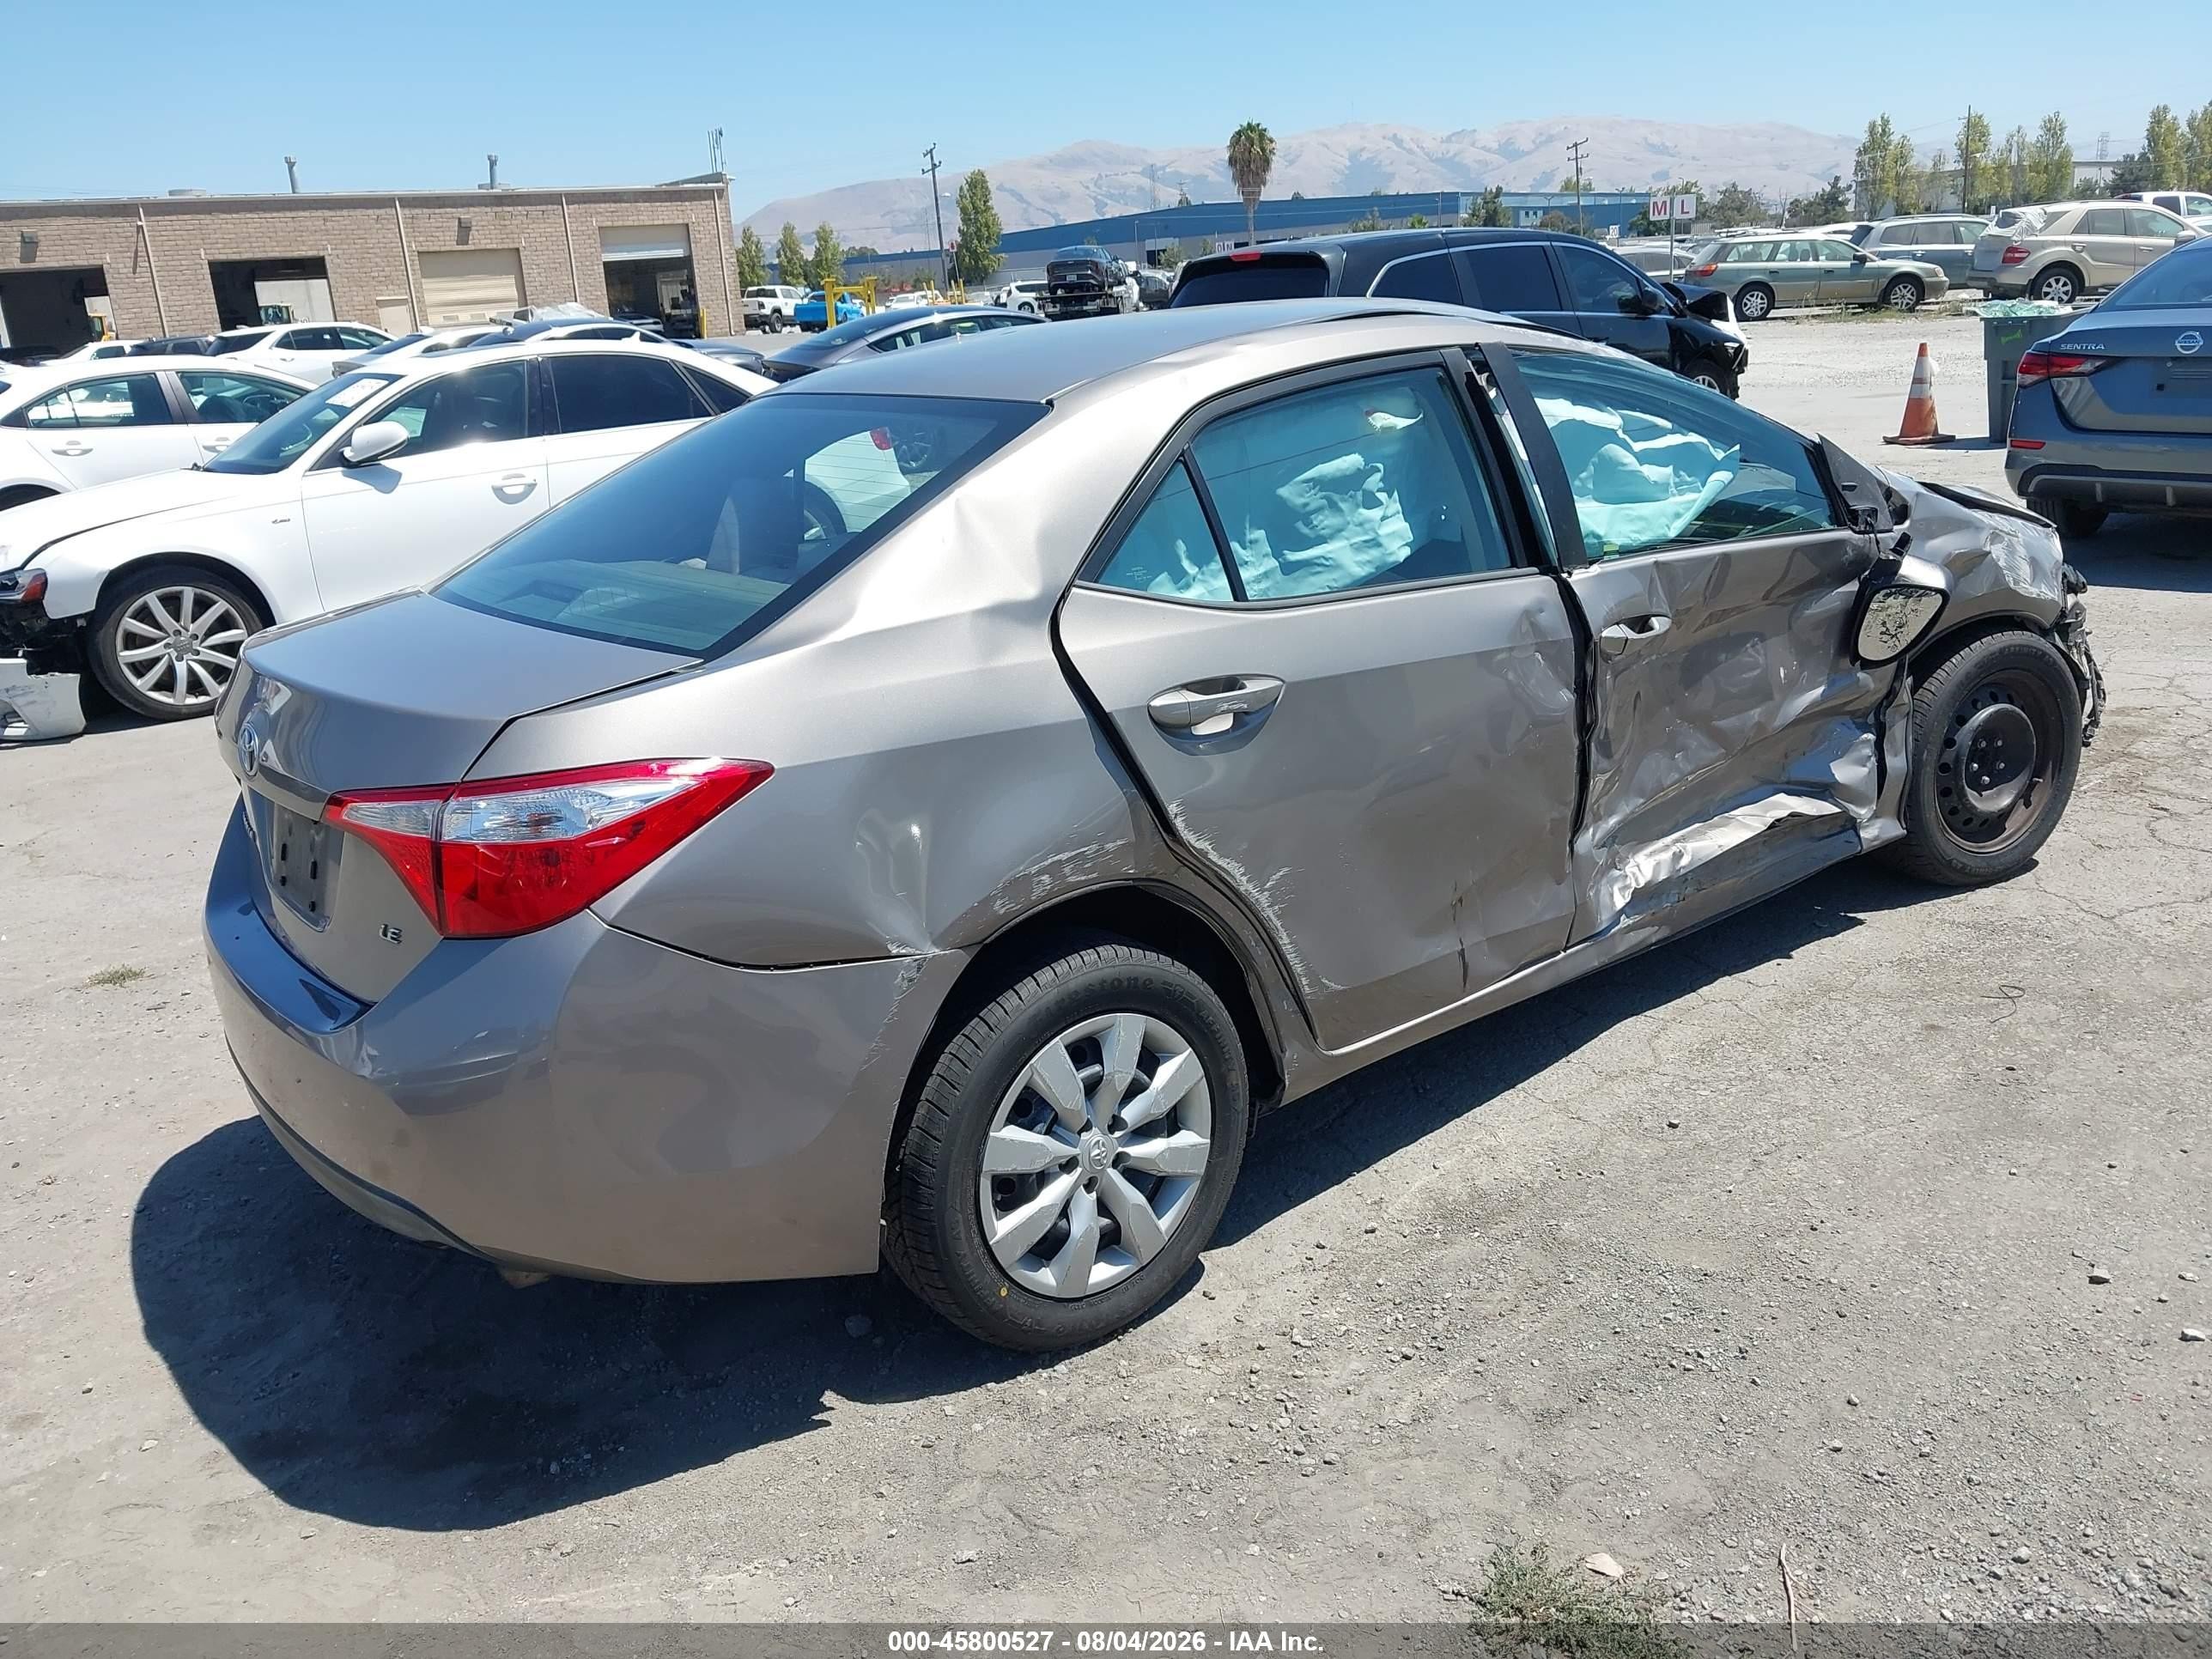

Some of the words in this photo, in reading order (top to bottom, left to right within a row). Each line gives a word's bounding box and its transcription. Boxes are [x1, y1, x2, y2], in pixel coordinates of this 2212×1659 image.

[1652, 200, 1668, 216] M
[1680, 198, 1690, 215] L
[379, 923, 403, 945] LE
